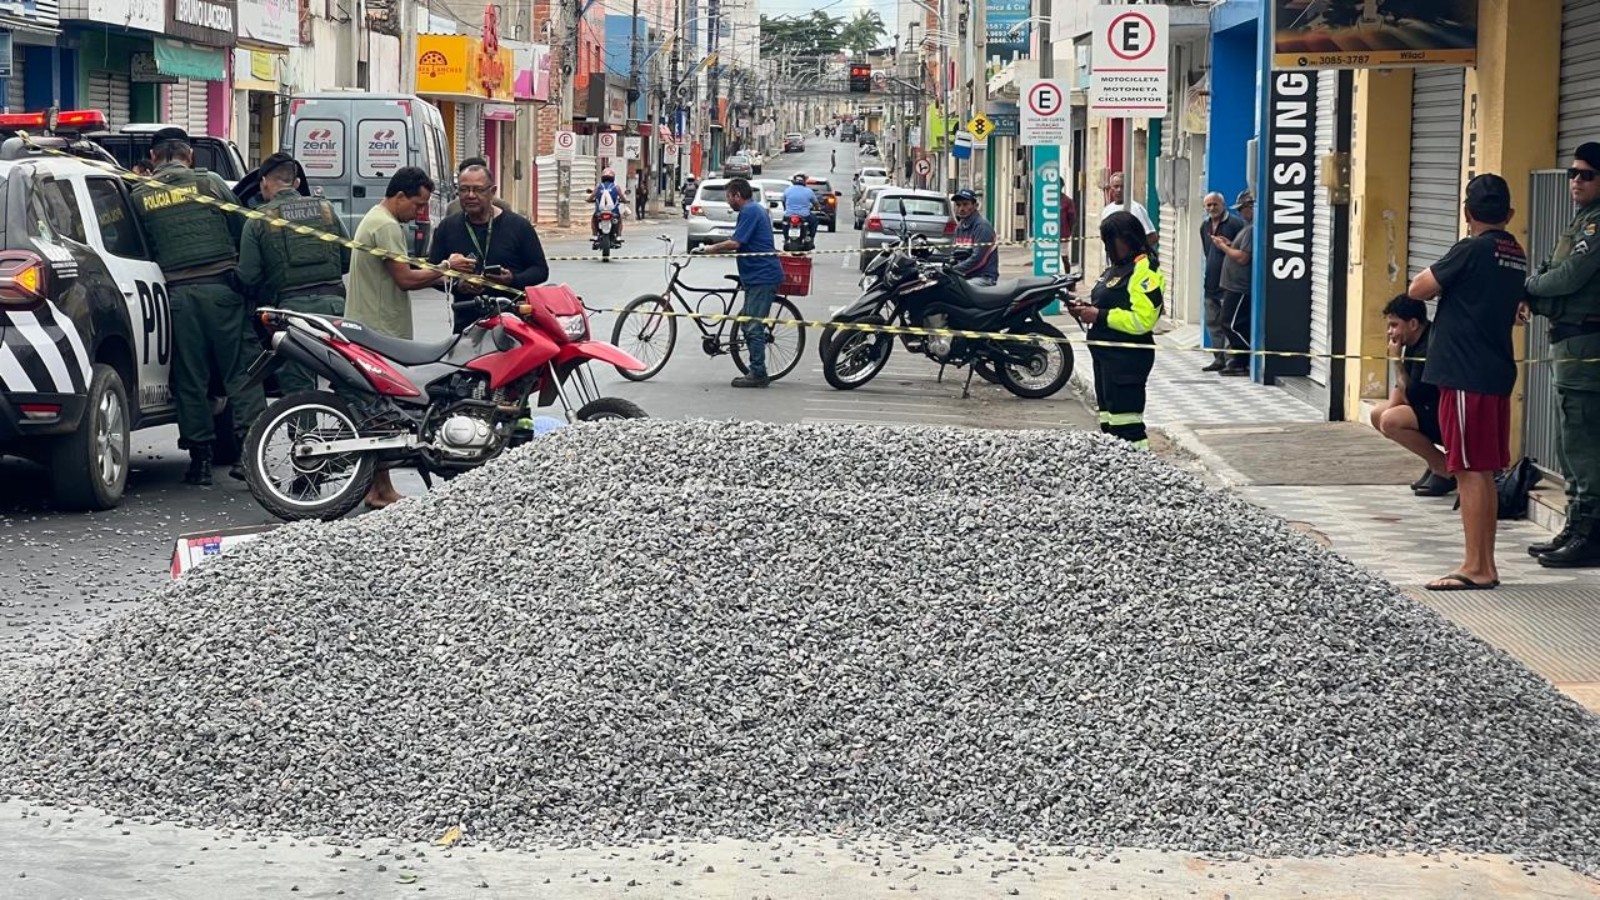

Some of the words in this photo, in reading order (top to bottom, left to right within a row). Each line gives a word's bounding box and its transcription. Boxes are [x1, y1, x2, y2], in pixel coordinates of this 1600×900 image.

[1123, 22, 1139, 51] E
[1319, 55, 1370, 65] 3085-3787
[1039, 90, 1051, 109] E
[303, 140, 336, 149] zenir
[368, 140, 399, 149] zenir
[1272, 73, 1309, 279] SAMSUNG
[283, 207, 321, 219] RURAL
